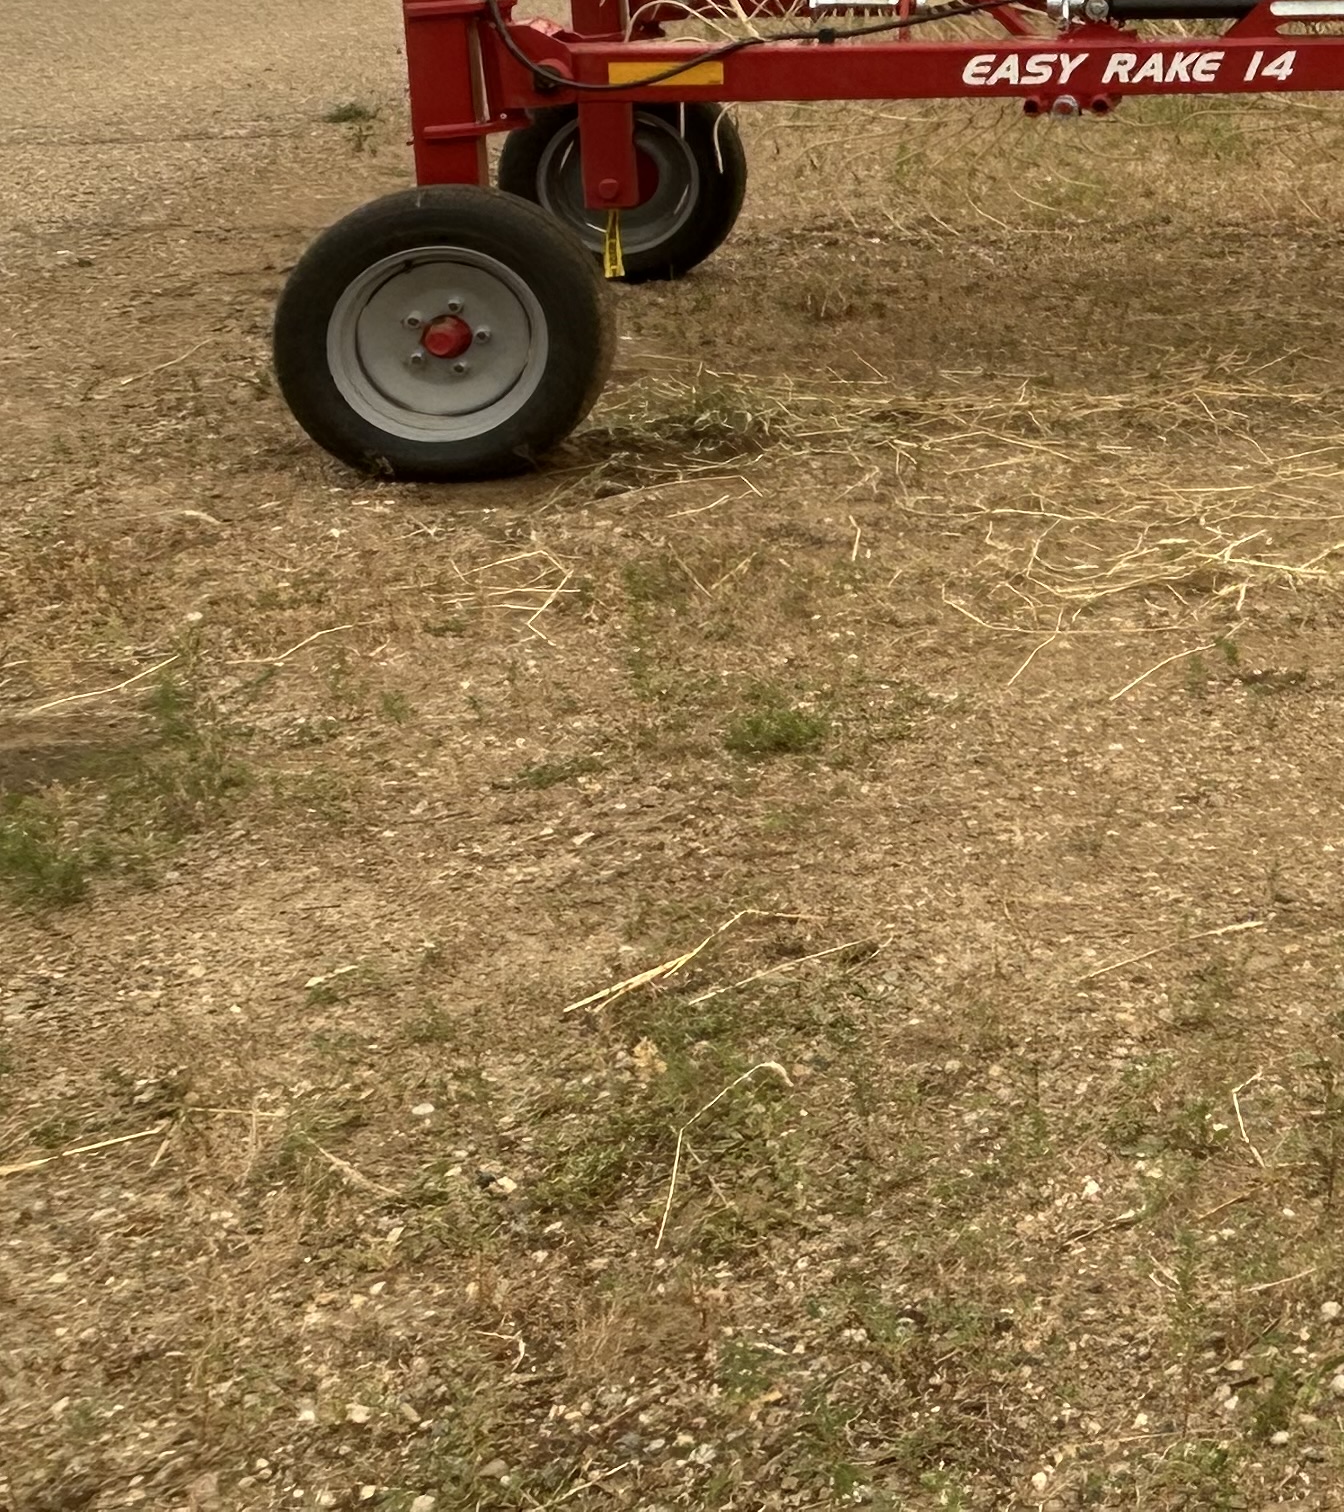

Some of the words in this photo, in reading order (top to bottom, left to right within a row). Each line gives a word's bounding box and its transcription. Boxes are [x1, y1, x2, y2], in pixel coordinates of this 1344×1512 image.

[961, 53, 1089, 86] EASY
[1101, 51, 1226, 84] RAKE
[1243, 50, 1297, 82] 14
